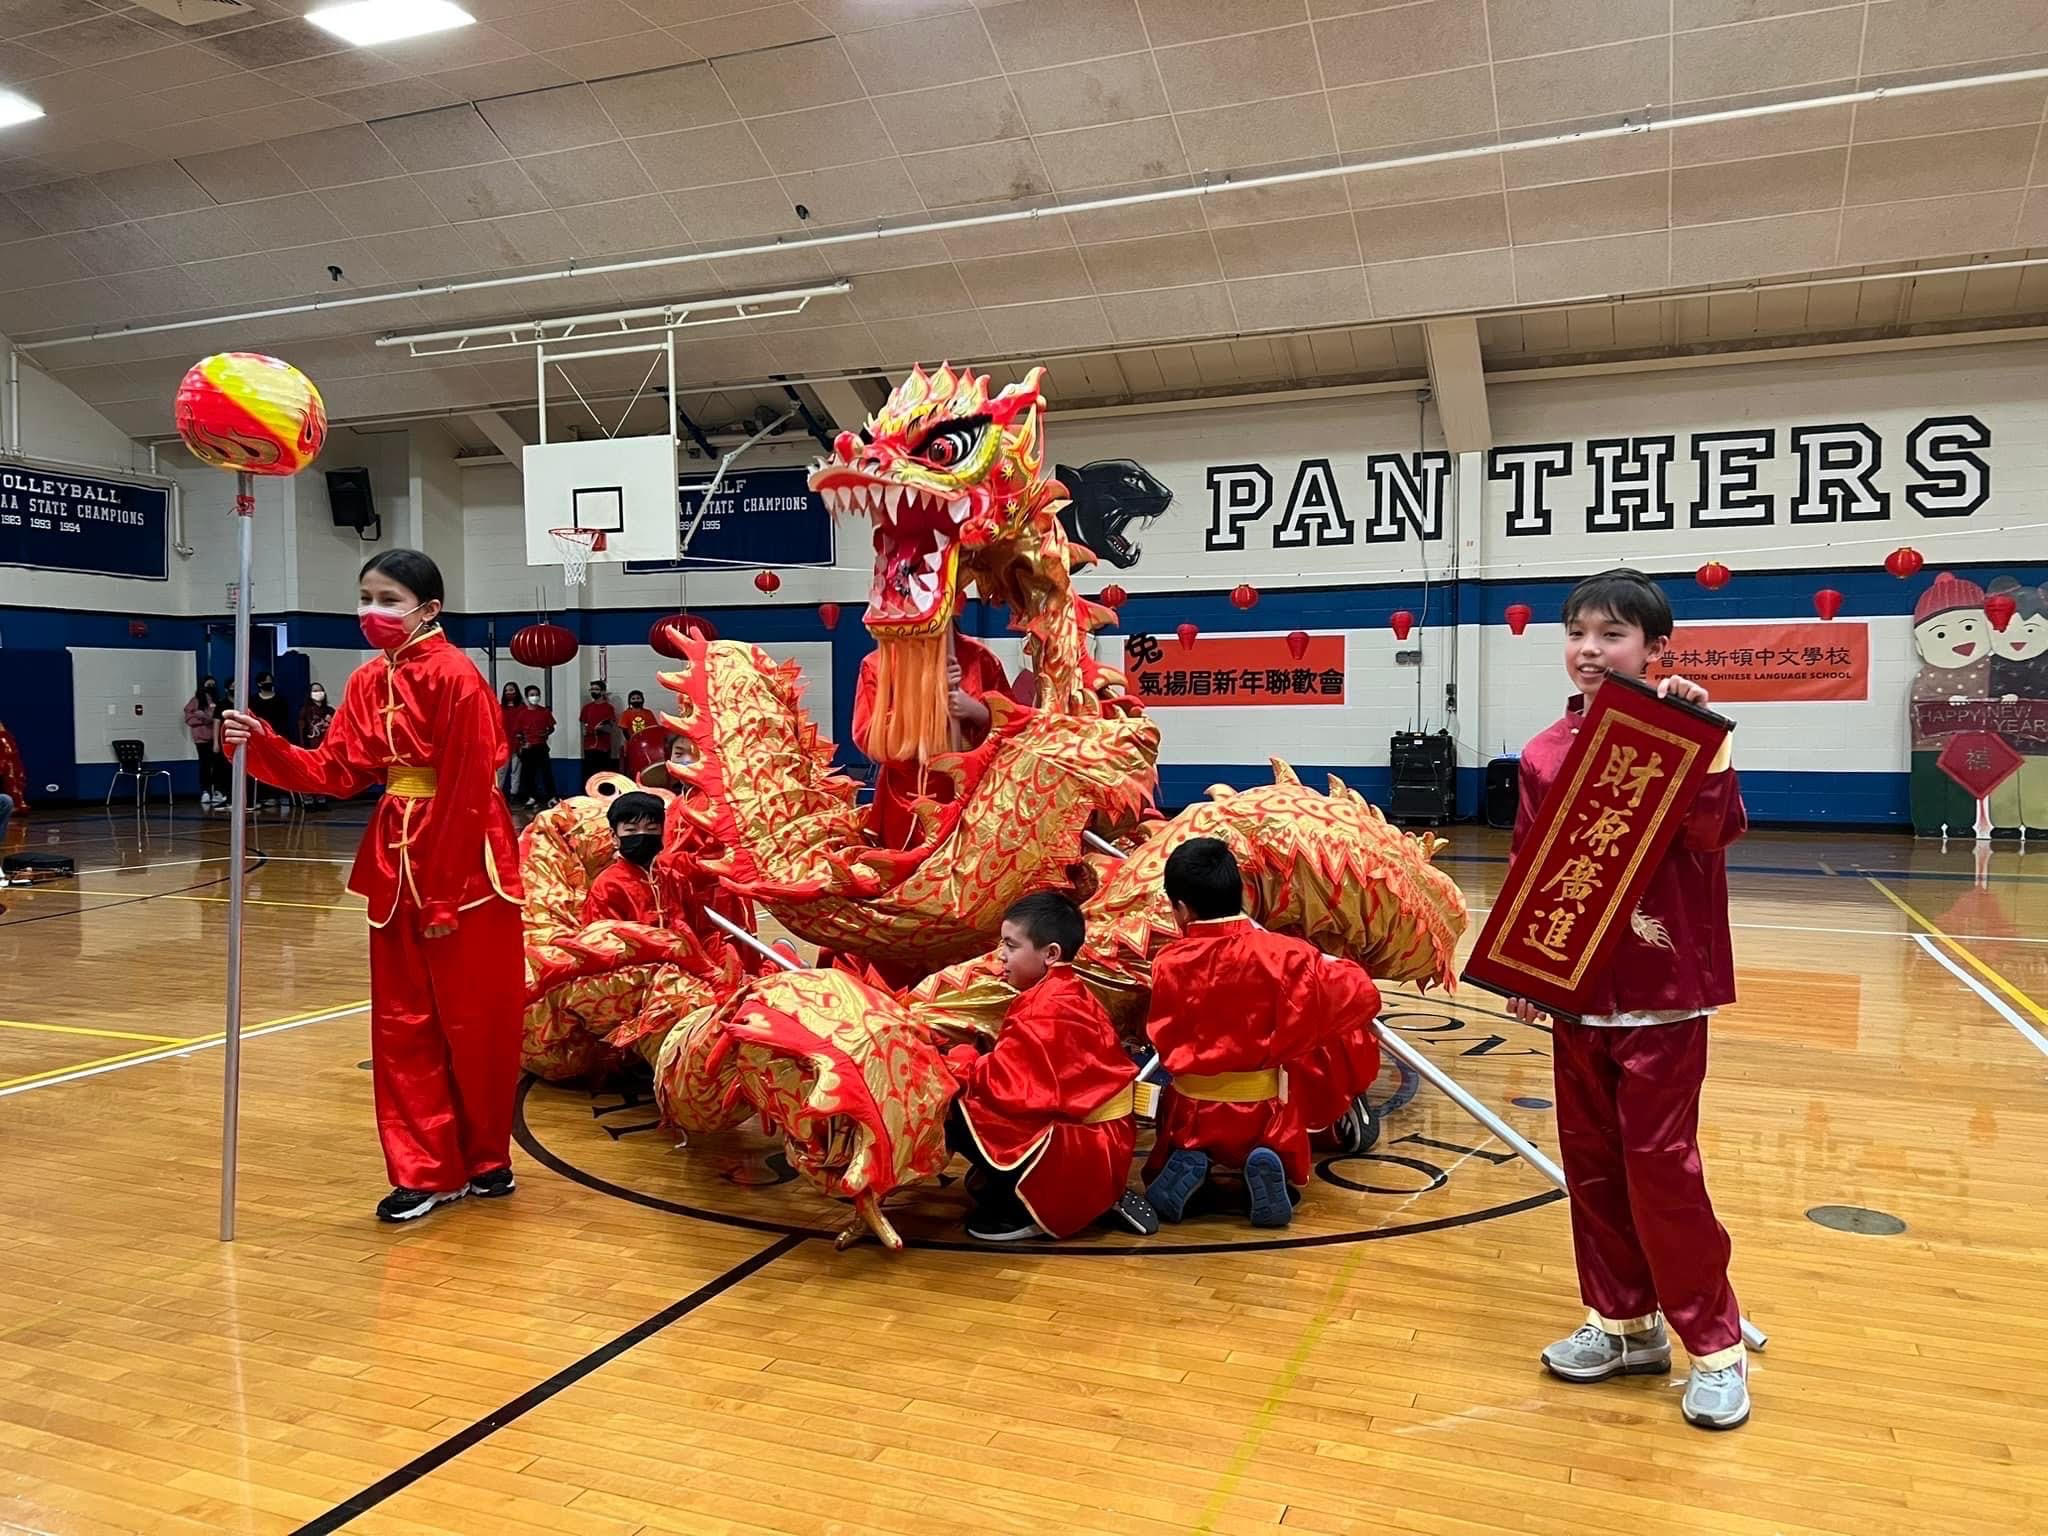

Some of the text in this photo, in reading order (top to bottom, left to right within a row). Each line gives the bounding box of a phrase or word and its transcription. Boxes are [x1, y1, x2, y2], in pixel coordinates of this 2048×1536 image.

[0, 474, 120, 503] OLLEYBALL
[1205, 416, 1992, 551] PANTHERS
[29, 498, 67, 516] STATE
[77, 504, 145, 526] CHAMPIONS
[743, 496, 808, 512] CHAMPIONS
[702, 520, 721, 530] 1995
[1660, 646, 1852, 668] 普林斯頓中文學校
[1138, 668, 1344, 696] 氣揚眉新年聯歡會
[1711, 673, 1751, 681] CHINESE
[1754, 672, 1807, 680] LANGUAGE
[1809, 671, 1852, 680] SCHOOL
[1919, 704, 2032, 723] HAPPY NEW
[1993, 719, 2048, 733] YEAR
[1522, 743, 1664, 961] 財源廣進
